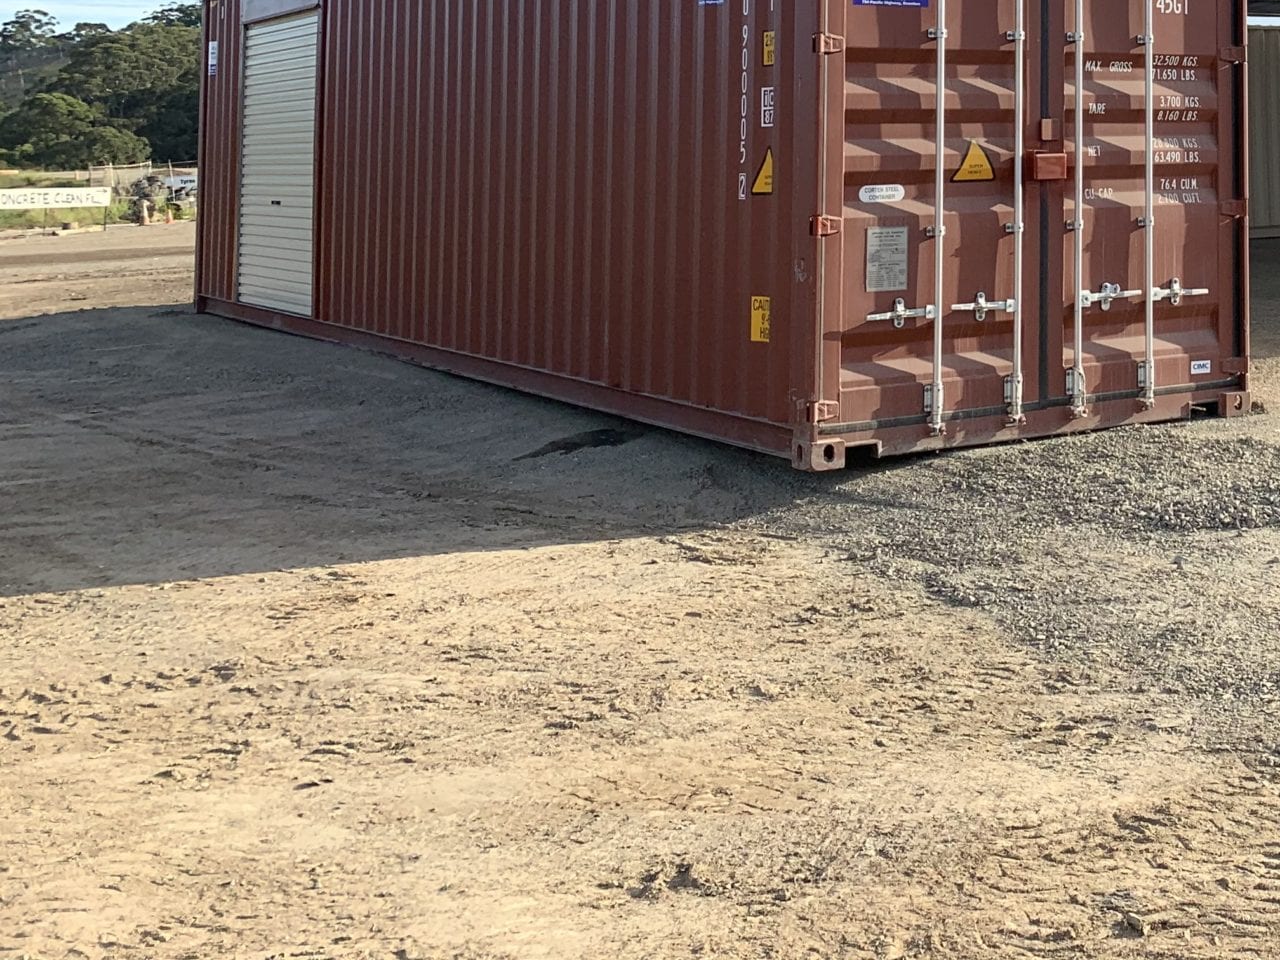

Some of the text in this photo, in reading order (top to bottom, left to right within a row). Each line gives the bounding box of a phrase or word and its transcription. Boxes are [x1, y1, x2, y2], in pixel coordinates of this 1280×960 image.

[1085, 56, 1199, 72] MAX. GROSS 32.500 KGS.
[1181, 70, 1198, 81] LBS.
[740, 25, 748, 163] 900005
[1089, 96, 1201, 114] TARE 3.700 KGS.
[764, 111, 774, 123] 87
[1157, 111, 1199, 121] 8.160 LBS.
[1088, 146, 1101, 157] NET
[1182, 138, 1200, 148] KGS.
[1154, 152, 1201, 163] 63.490 LBS.
[739, 173, 746, 199] 2
[1160, 179, 1177, 189] 76.4
[1193, 362, 1209, 370] CIMC
